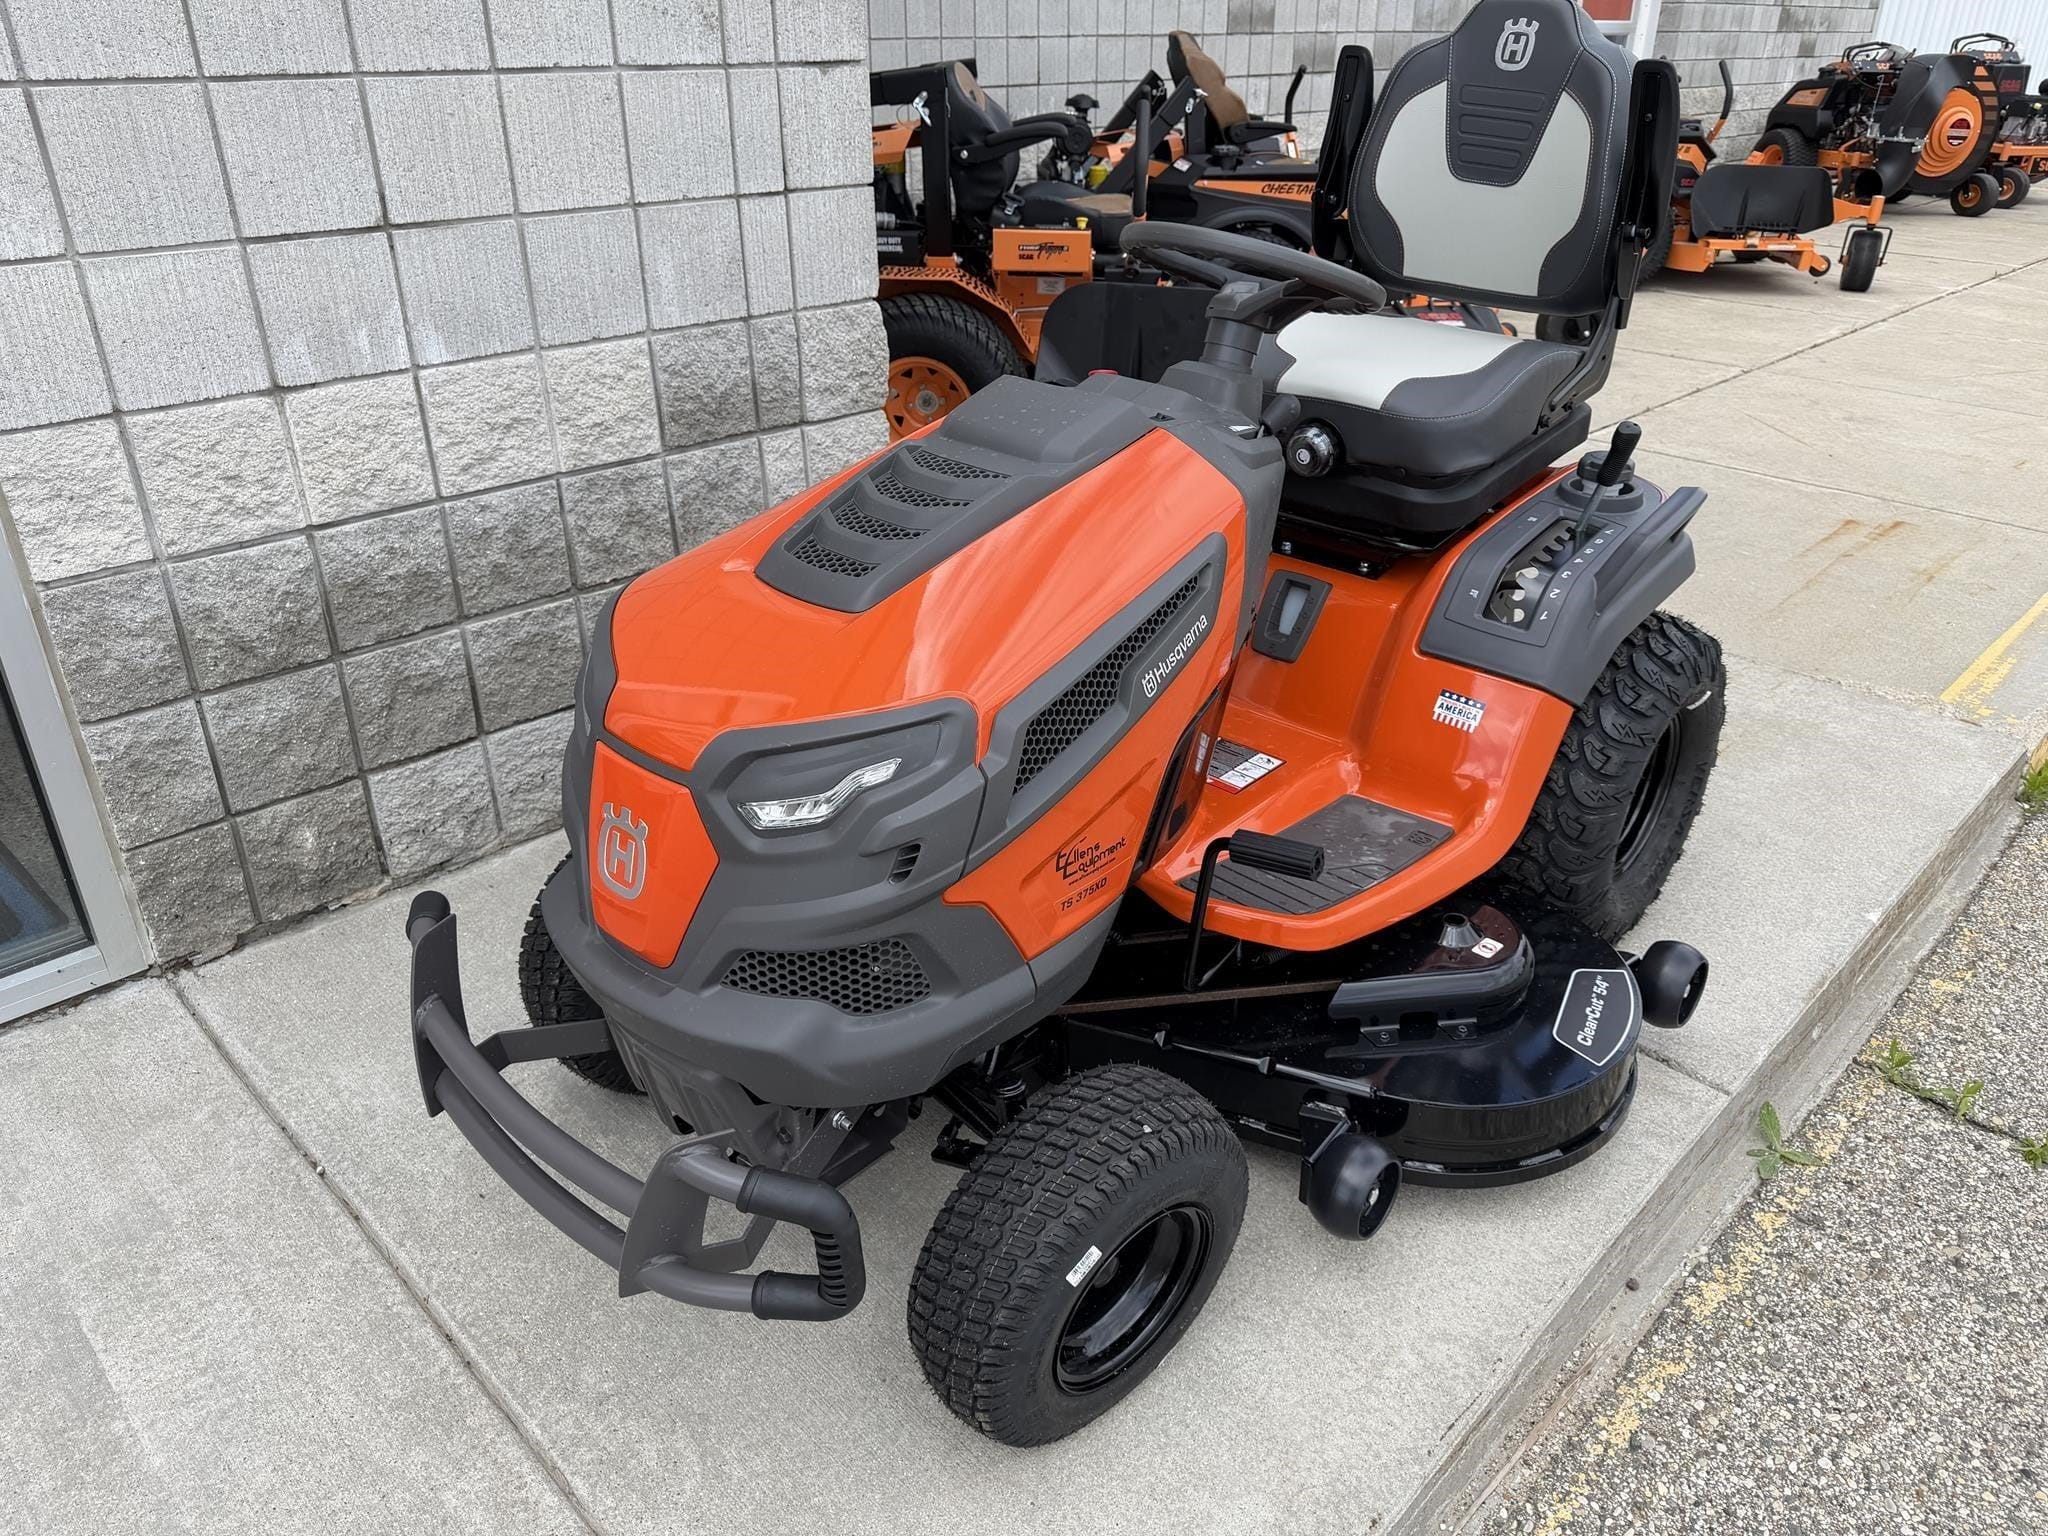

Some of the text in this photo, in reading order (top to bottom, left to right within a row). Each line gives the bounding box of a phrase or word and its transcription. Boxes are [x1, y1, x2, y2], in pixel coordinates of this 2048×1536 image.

[1561, 571, 1572, 579] 3
[1549, 588, 1561, 599] 2
[1539, 610, 1549, 621] 1
[1153, 614, 1208, 684] Husqvarna
[1437, 701, 1478, 722] AMERICA
[1063, 837, 1126, 880] Equipment
[1060, 877, 1108, 912] TS 375XD
